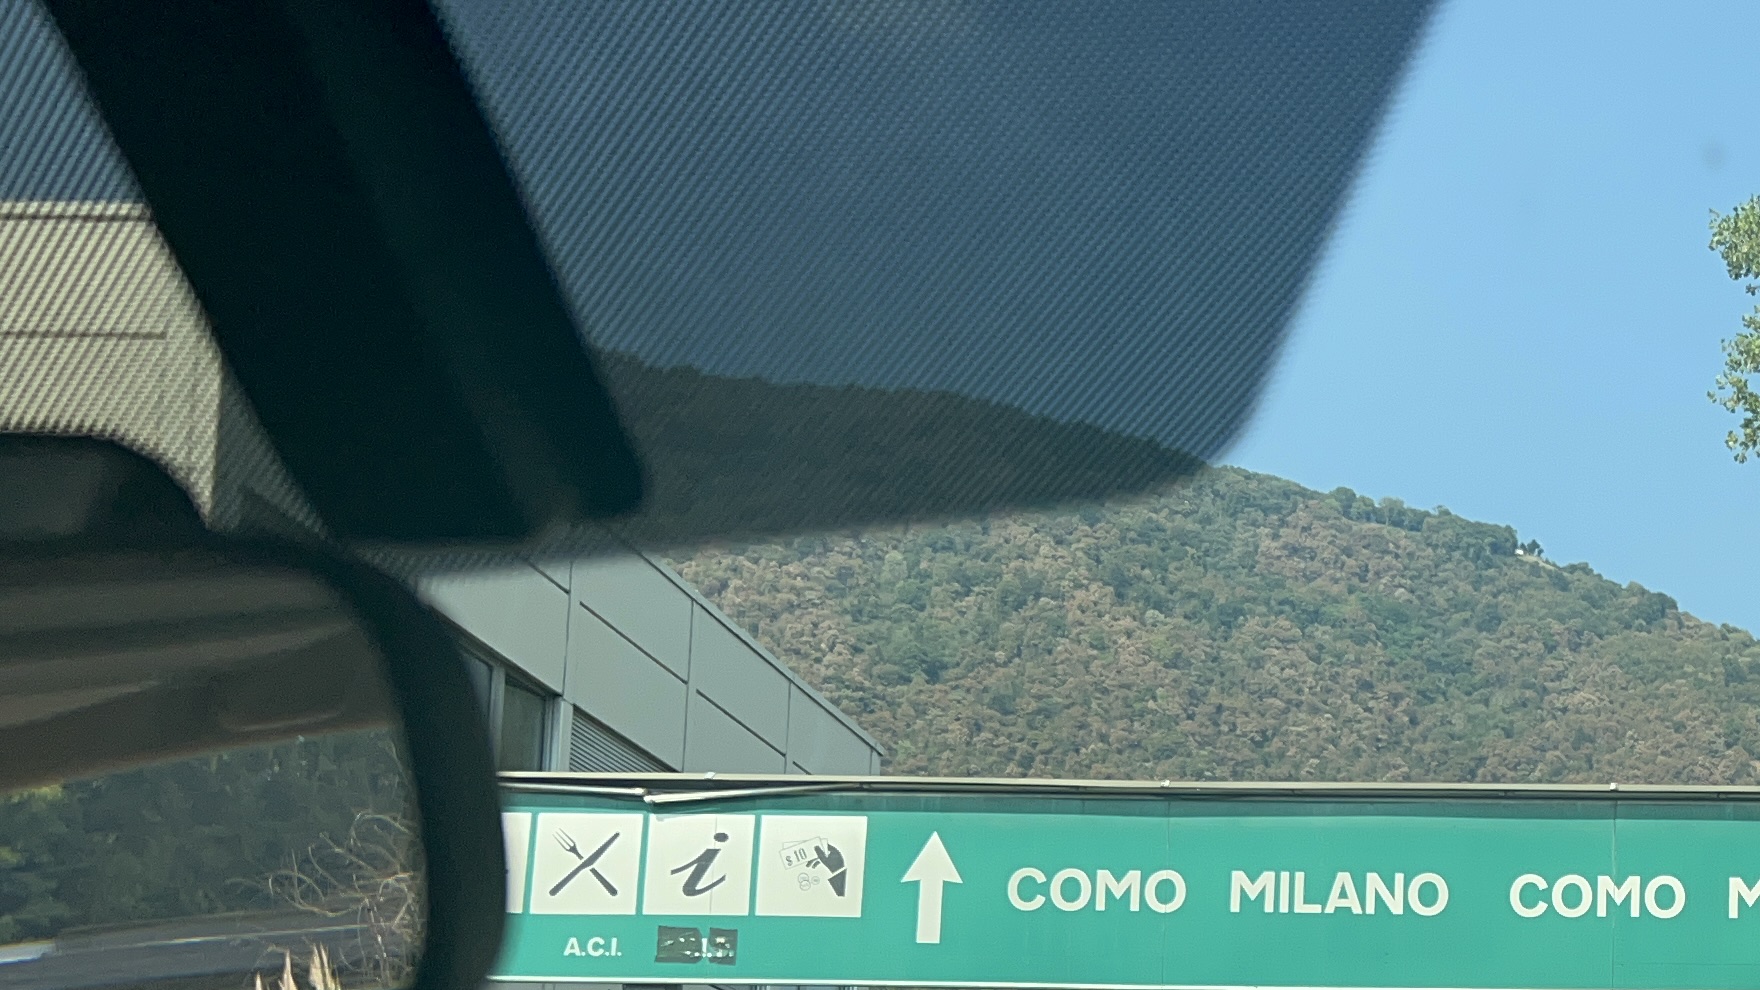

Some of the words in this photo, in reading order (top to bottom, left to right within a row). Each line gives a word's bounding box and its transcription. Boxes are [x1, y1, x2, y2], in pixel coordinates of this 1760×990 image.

[1007, 867, 1187, 914] COMO
[1229, 870, 1449, 917] MILANO
[1509, 873, 1686, 919] COMO
[563, 936, 623, 958] A.C.I.
